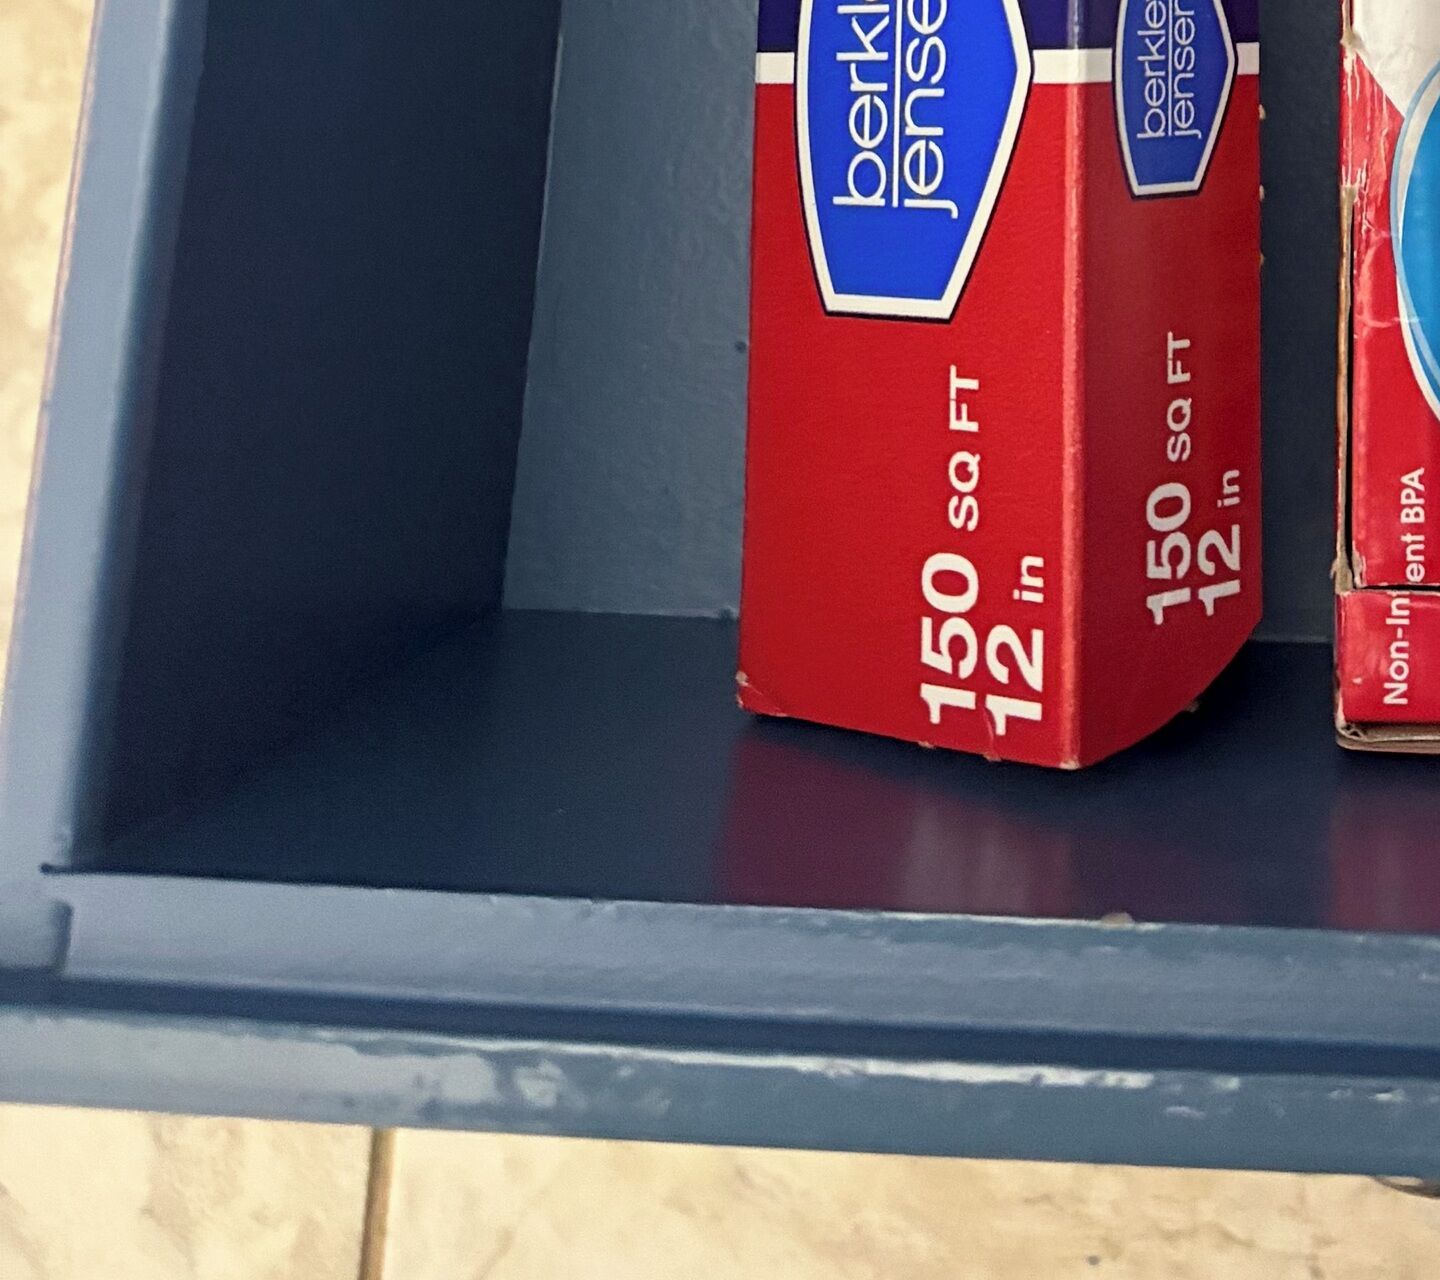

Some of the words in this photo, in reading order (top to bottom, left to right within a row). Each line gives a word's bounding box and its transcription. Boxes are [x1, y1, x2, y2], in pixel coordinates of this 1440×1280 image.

[1167, 331, 1191, 384] FT
[949, 365, 979, 433] FT
[1166, 397, 1192, 463] SQ
[948, 450, 980, 532] SQ
[1217, 469, 1241, 508] in
[1400, 467, 1425, 524] BPA
[1012, 555, 1044, 604] in
[1145, 482, 1192, 626] 150
[1197, 524, 1241, 617] 12
[919, 552, 979, 724] 150
[984, 624, 1044, 736] 12
